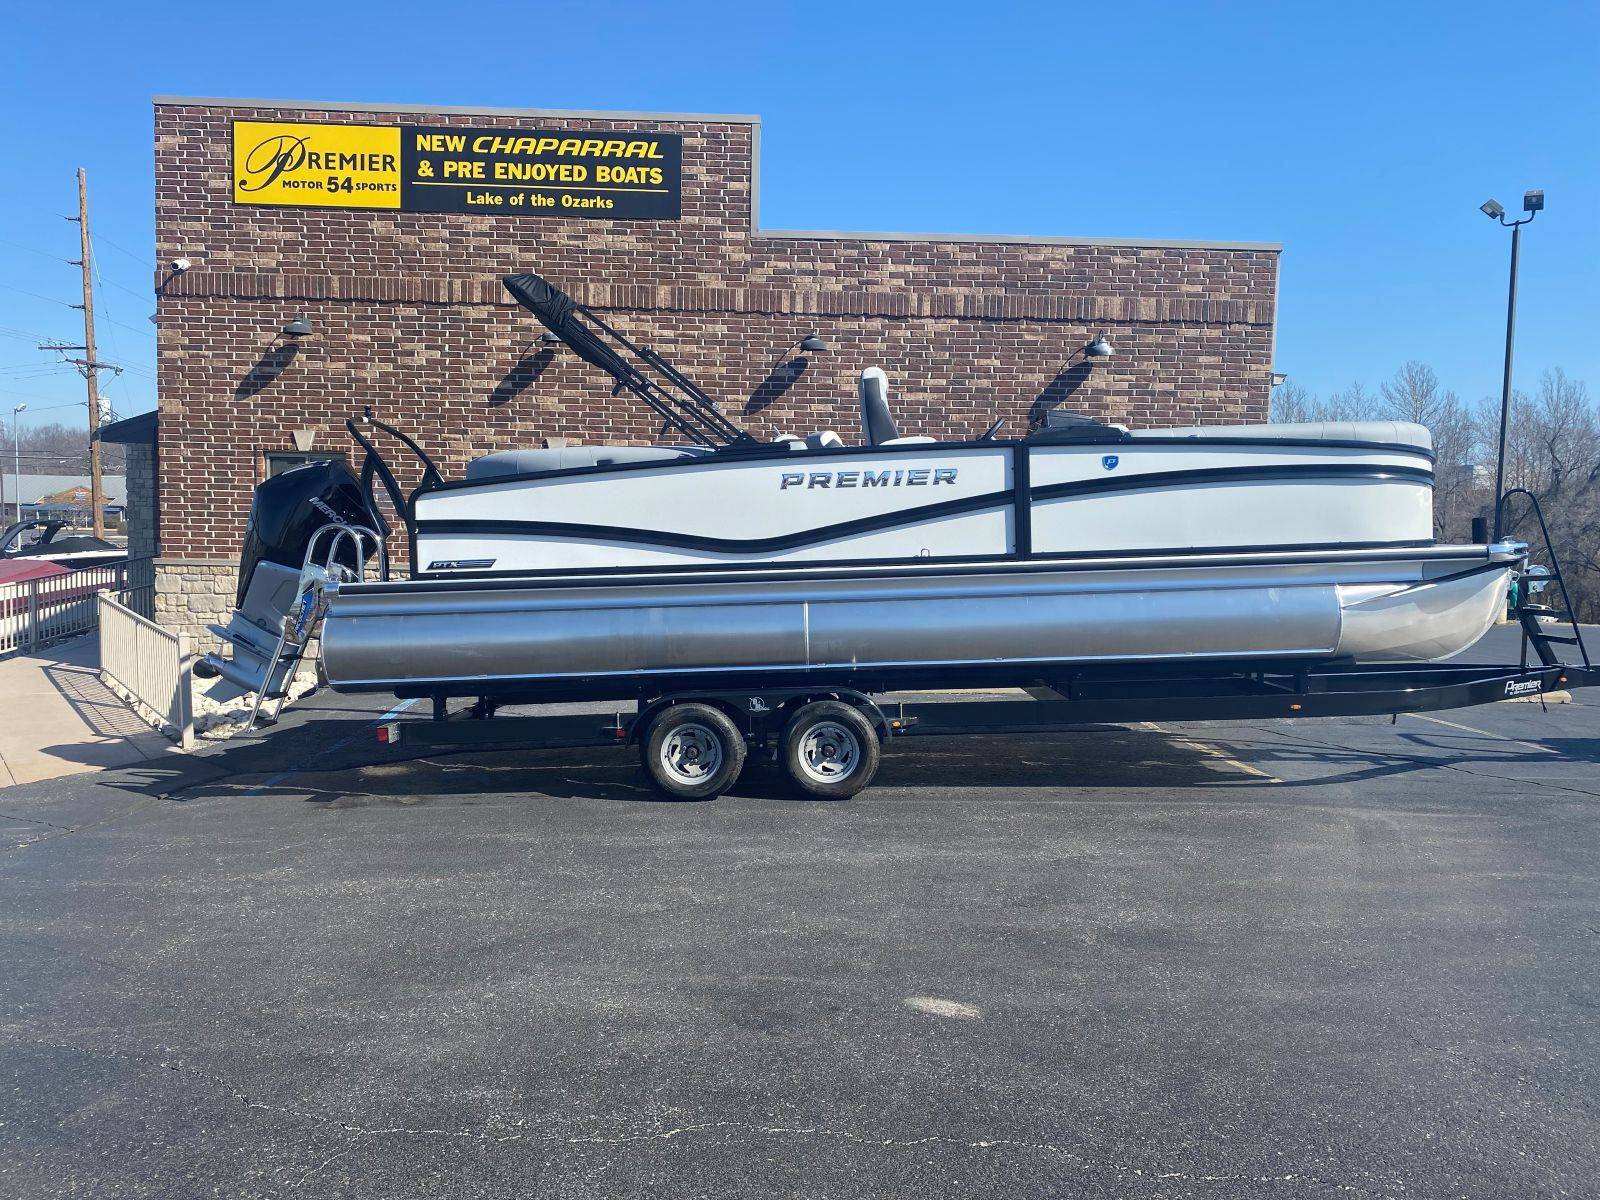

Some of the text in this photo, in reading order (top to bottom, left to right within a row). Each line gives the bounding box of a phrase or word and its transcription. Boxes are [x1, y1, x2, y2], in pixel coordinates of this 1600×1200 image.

[416, 134, 665, 158] NEW CHAPARRAL
[238, 135, 397, 191] PREMIER
[417, 160, 663, 185] & PRE ENJOYED BOATS
[282, 176, 397, 194] MOTOR 54 SPORTS
[467, 191, 614, 209] Lake of the Ozarks
[779, 468, 959, 490] PREMIER
